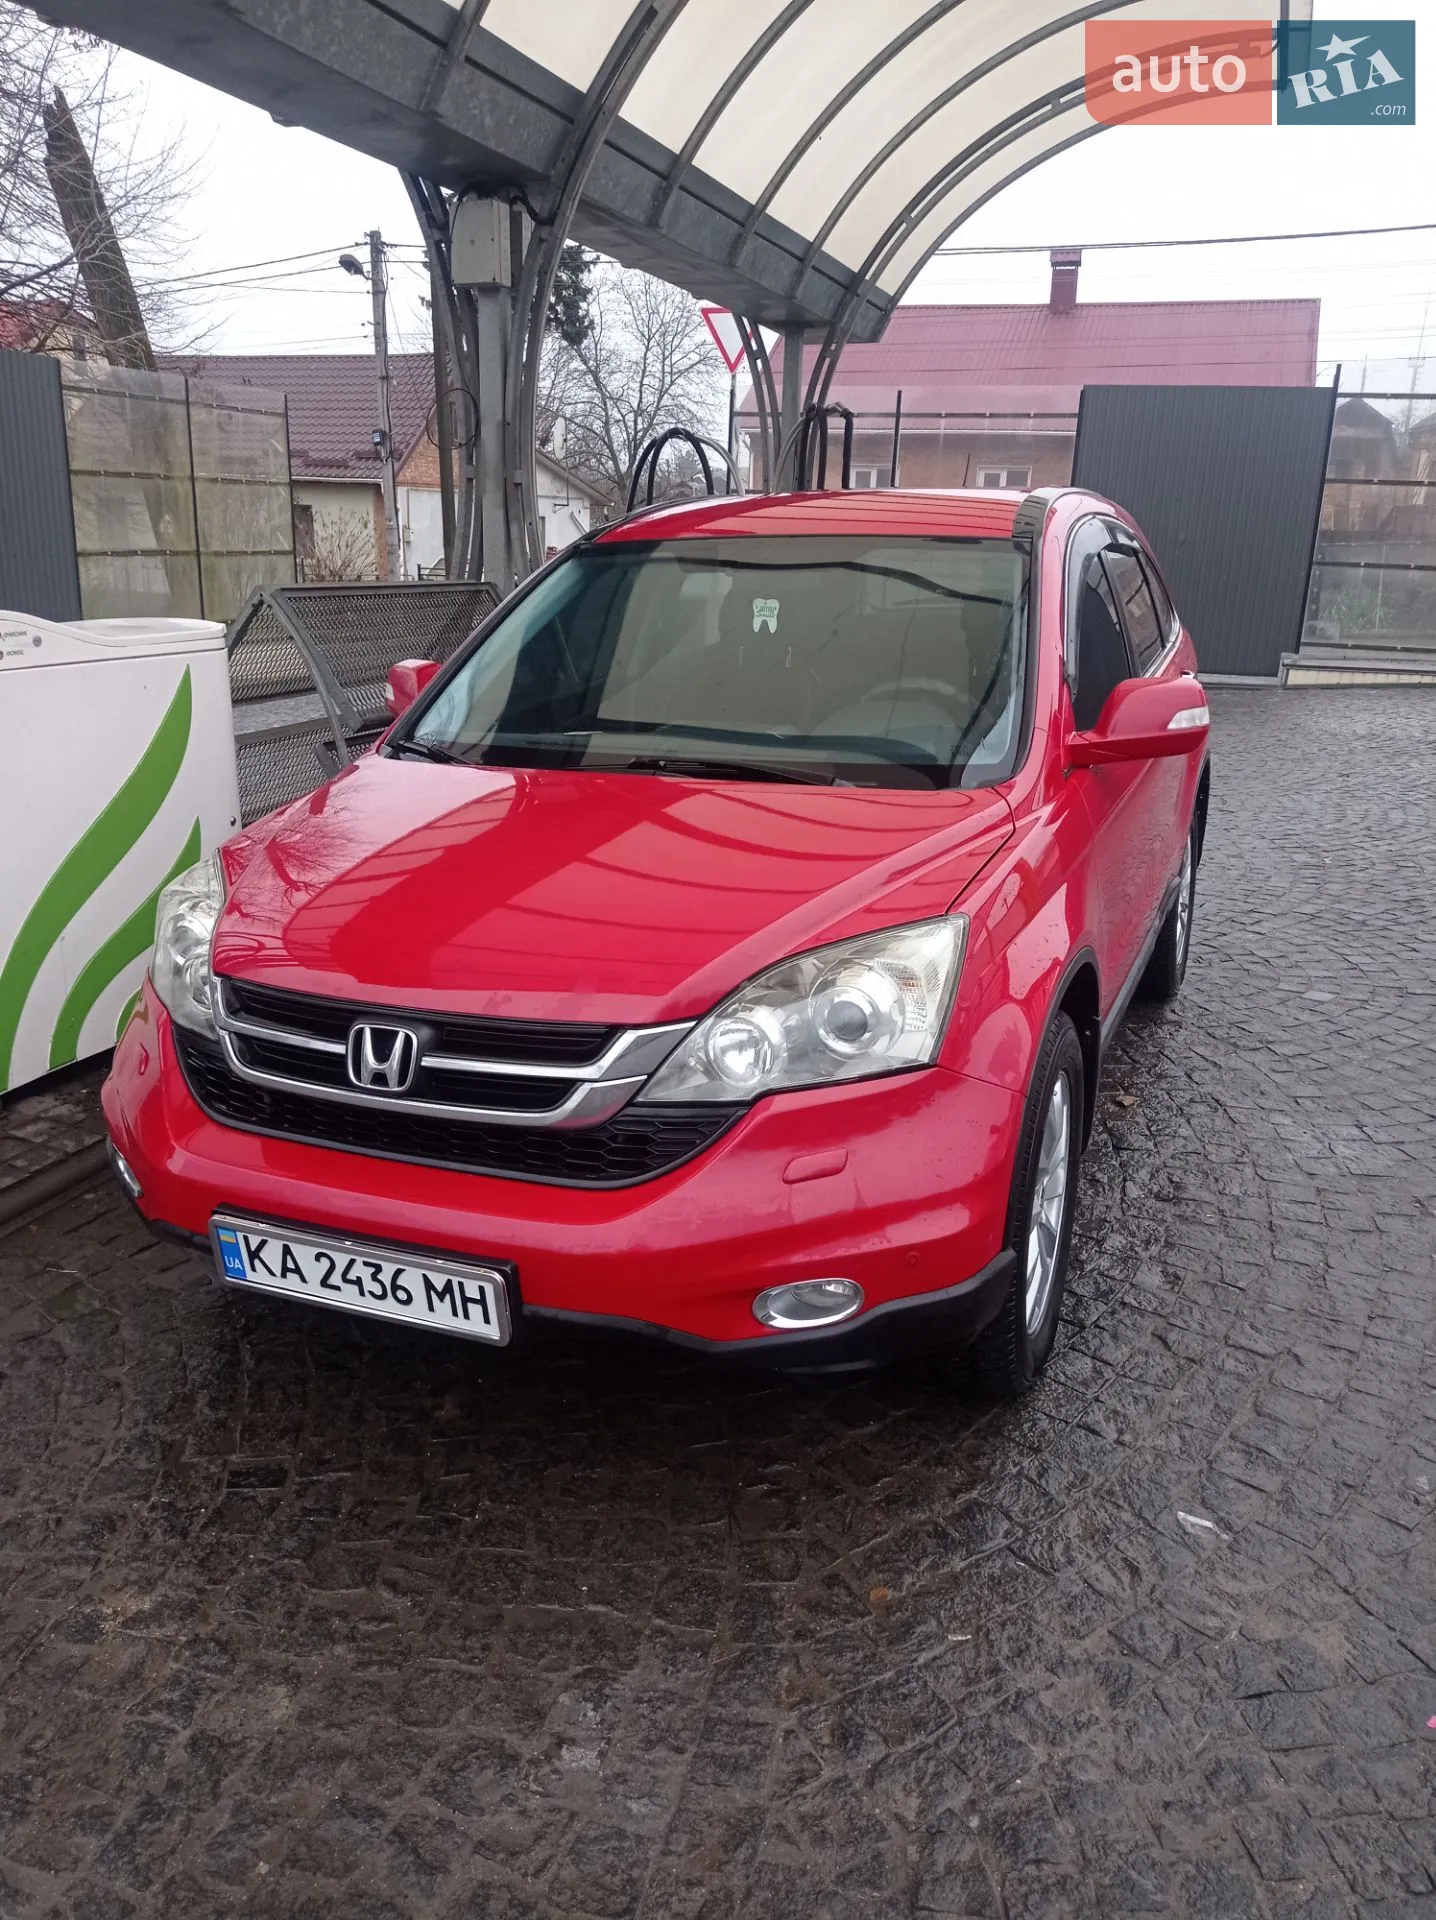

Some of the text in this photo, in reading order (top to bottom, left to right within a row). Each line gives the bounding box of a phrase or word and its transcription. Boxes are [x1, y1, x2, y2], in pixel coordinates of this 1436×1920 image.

[225, 1255, 243, 1272] UA
[243, 1234, 491, 1325] KA 2436 MH
